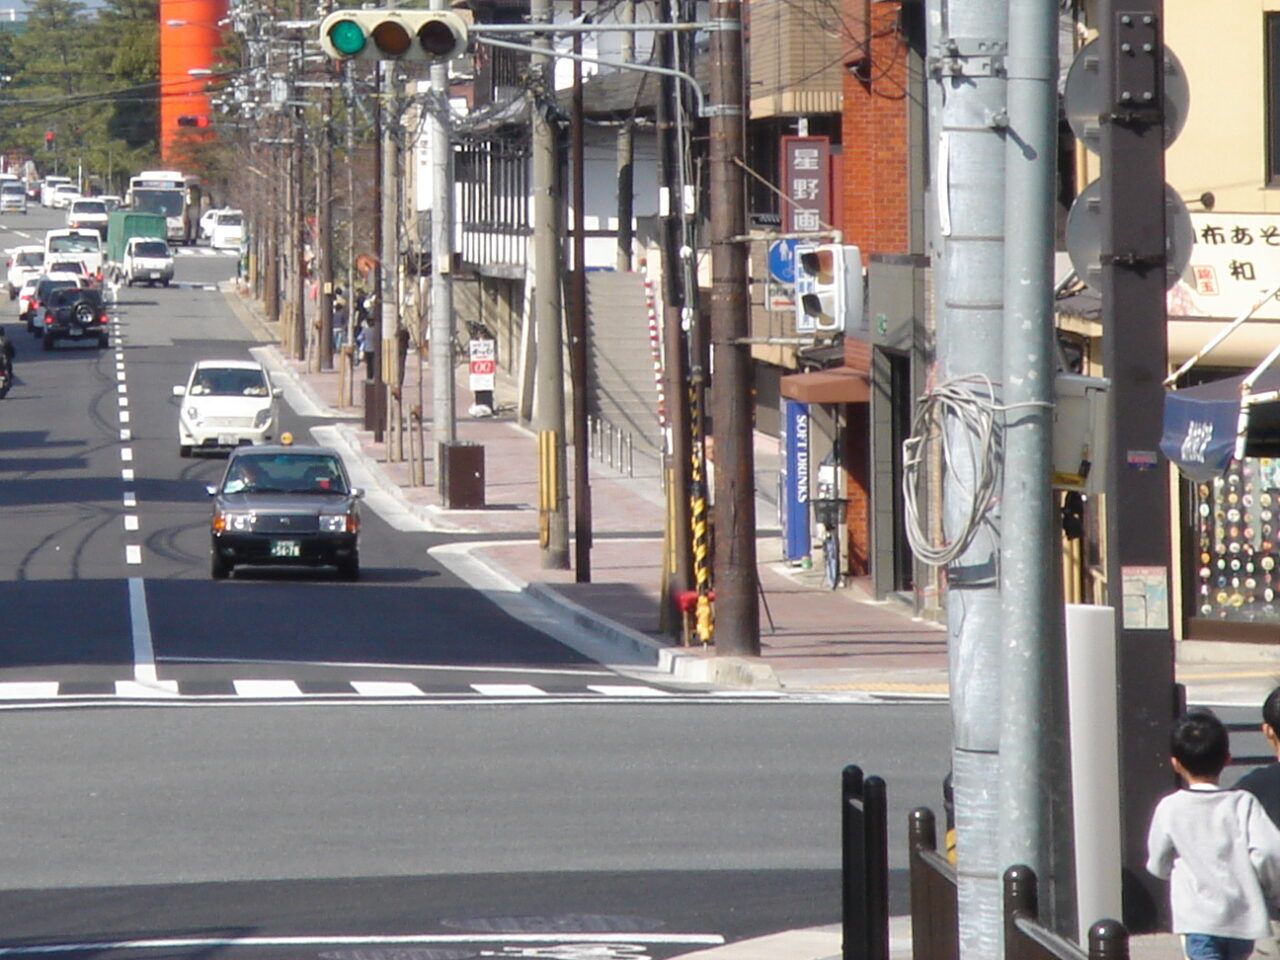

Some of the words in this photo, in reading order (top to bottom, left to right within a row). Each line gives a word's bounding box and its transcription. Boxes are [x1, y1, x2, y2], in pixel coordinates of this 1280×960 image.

[1193, 224, 1280, 246] 布あそ
[796, 414, 808, 448] SOFT
[796, 451, 808, 504] DRINKS
